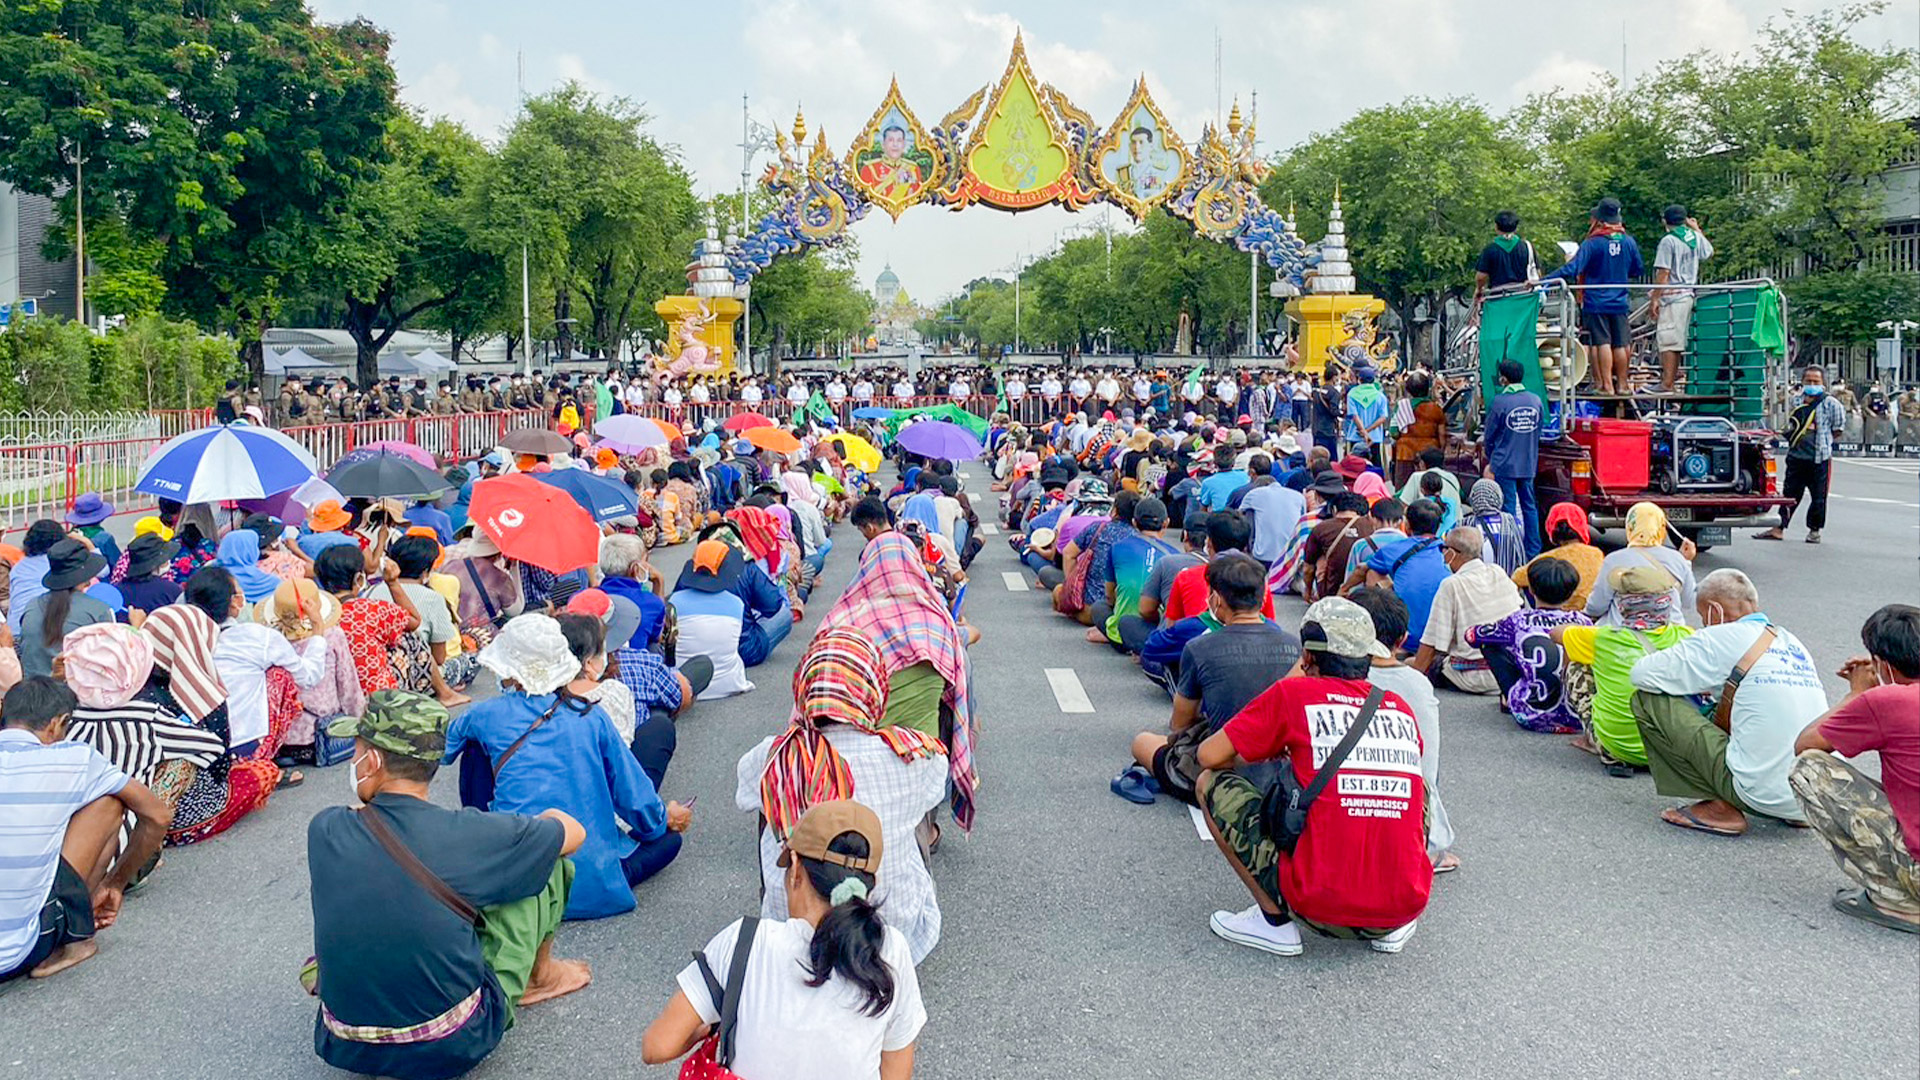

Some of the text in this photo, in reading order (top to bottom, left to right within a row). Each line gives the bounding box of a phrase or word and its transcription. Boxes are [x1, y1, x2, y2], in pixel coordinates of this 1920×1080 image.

[1870, 444, 1889, 452] POLICE
[487, 516, 504, 538] TOTAL
[1519, 632, 1564, 713] 3
[1340, 797, 1409, 811] SANFRANSISCO
[1347, 807, 1402, 820] CALIFORNIA
